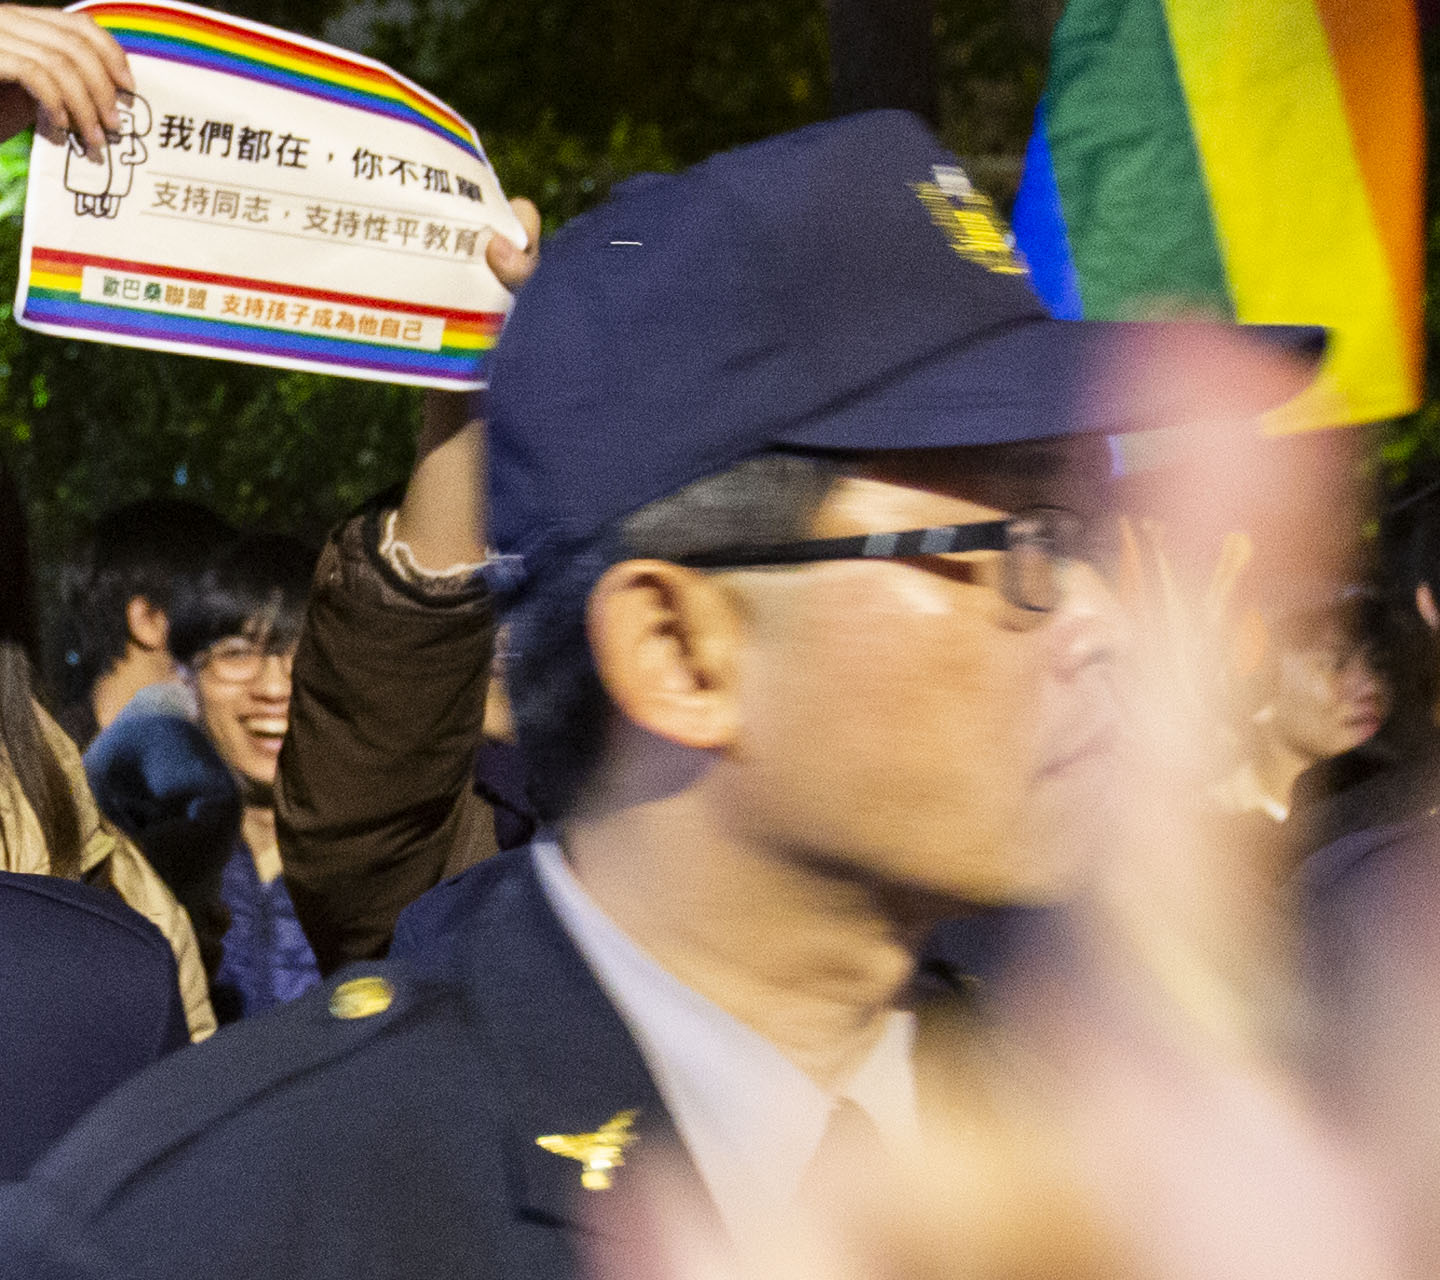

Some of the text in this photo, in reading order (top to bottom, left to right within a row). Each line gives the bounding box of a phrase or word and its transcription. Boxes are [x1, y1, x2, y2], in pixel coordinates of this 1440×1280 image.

[151, 181, 480, 257] 支持同志，支持性平教育
[102, 274, 424, 344] 歐巴桑聯盟 支持孩子成為他自己
